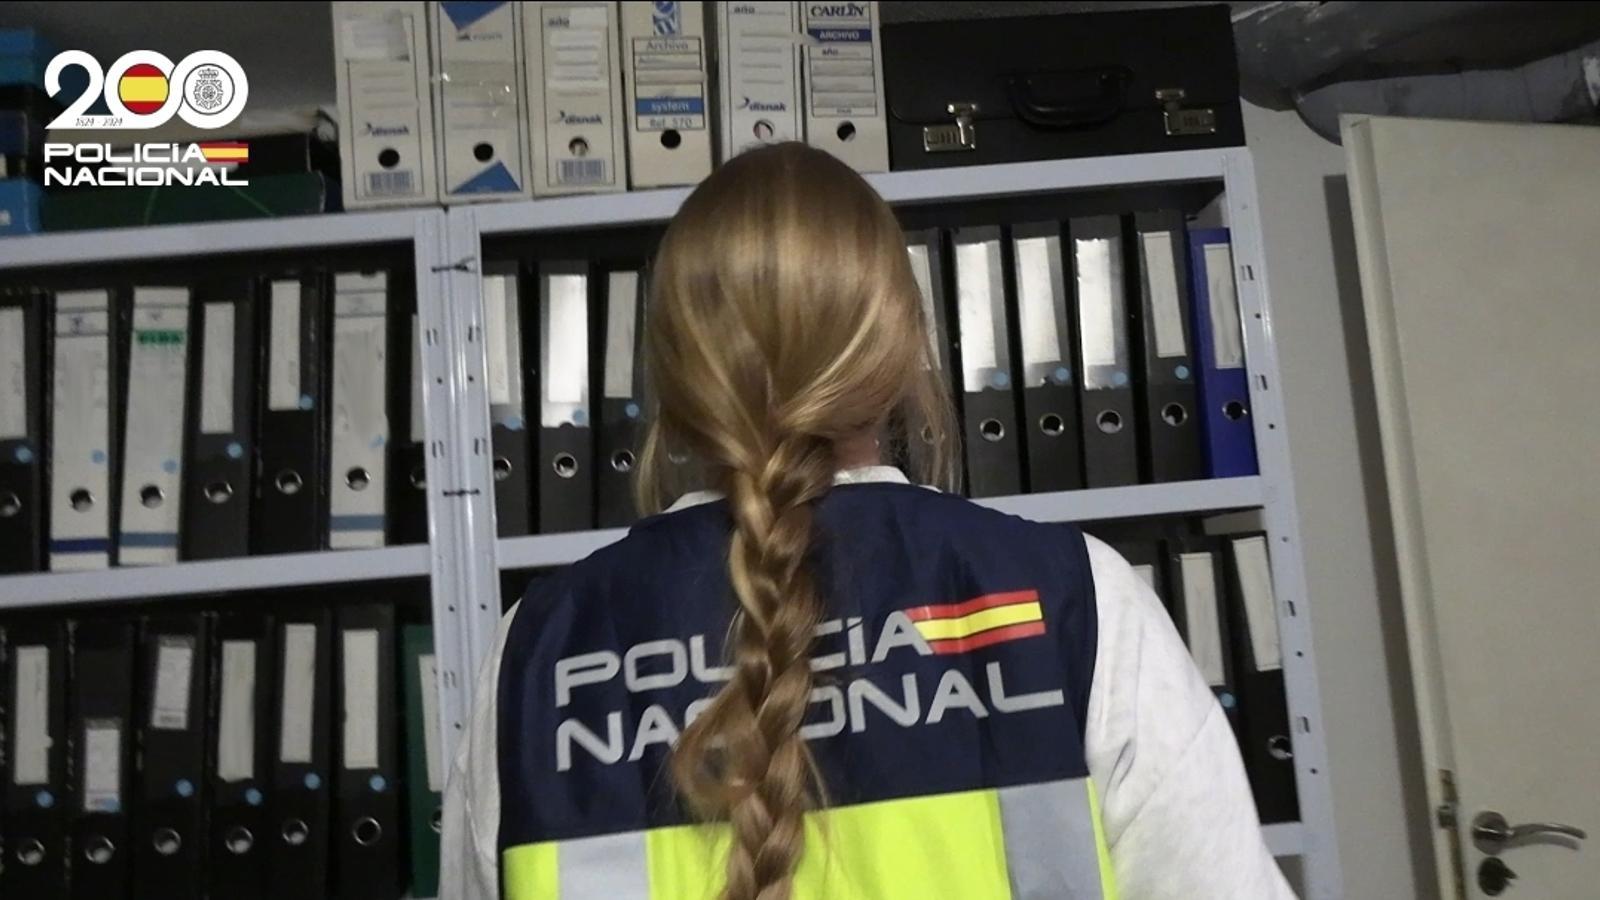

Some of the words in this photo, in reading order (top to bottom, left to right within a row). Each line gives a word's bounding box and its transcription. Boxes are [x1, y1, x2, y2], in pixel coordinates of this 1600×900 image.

[749, 101, 787, 113] disnak
[555, 609, 935, 708] POLÍA
[554, 661, 1064, 772] NAONAL
